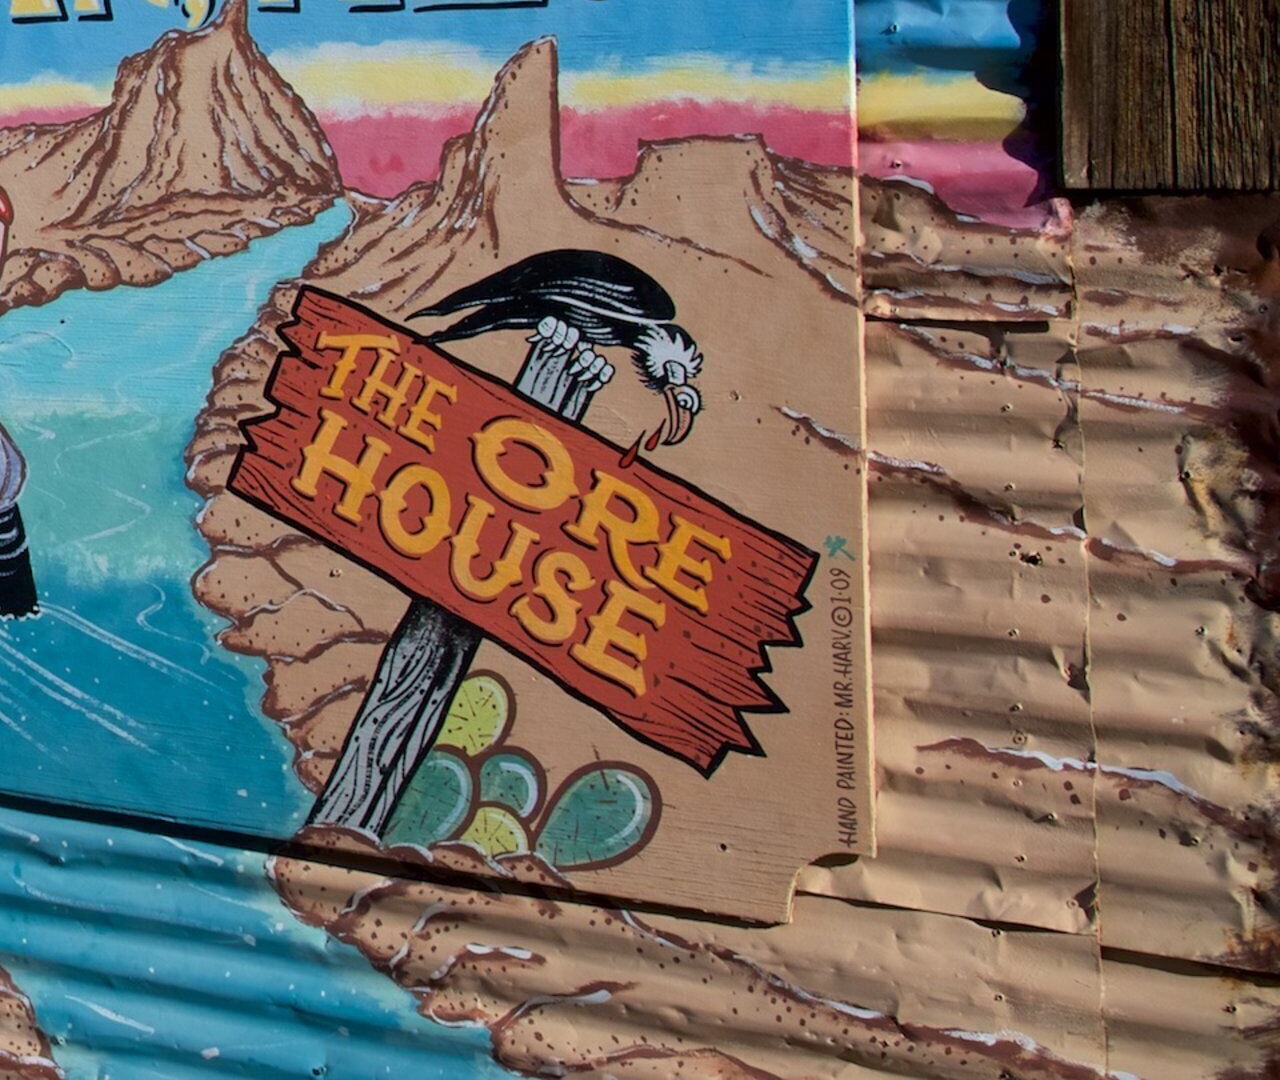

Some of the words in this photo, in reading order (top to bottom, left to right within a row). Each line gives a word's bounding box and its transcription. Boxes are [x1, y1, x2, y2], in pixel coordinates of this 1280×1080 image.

[290, 407, 668, 699] HOUSE
[316, 330, 459, 454] THE
[471, 413, 733, 617] ORE
[837, 796, 859, 849] HAND
